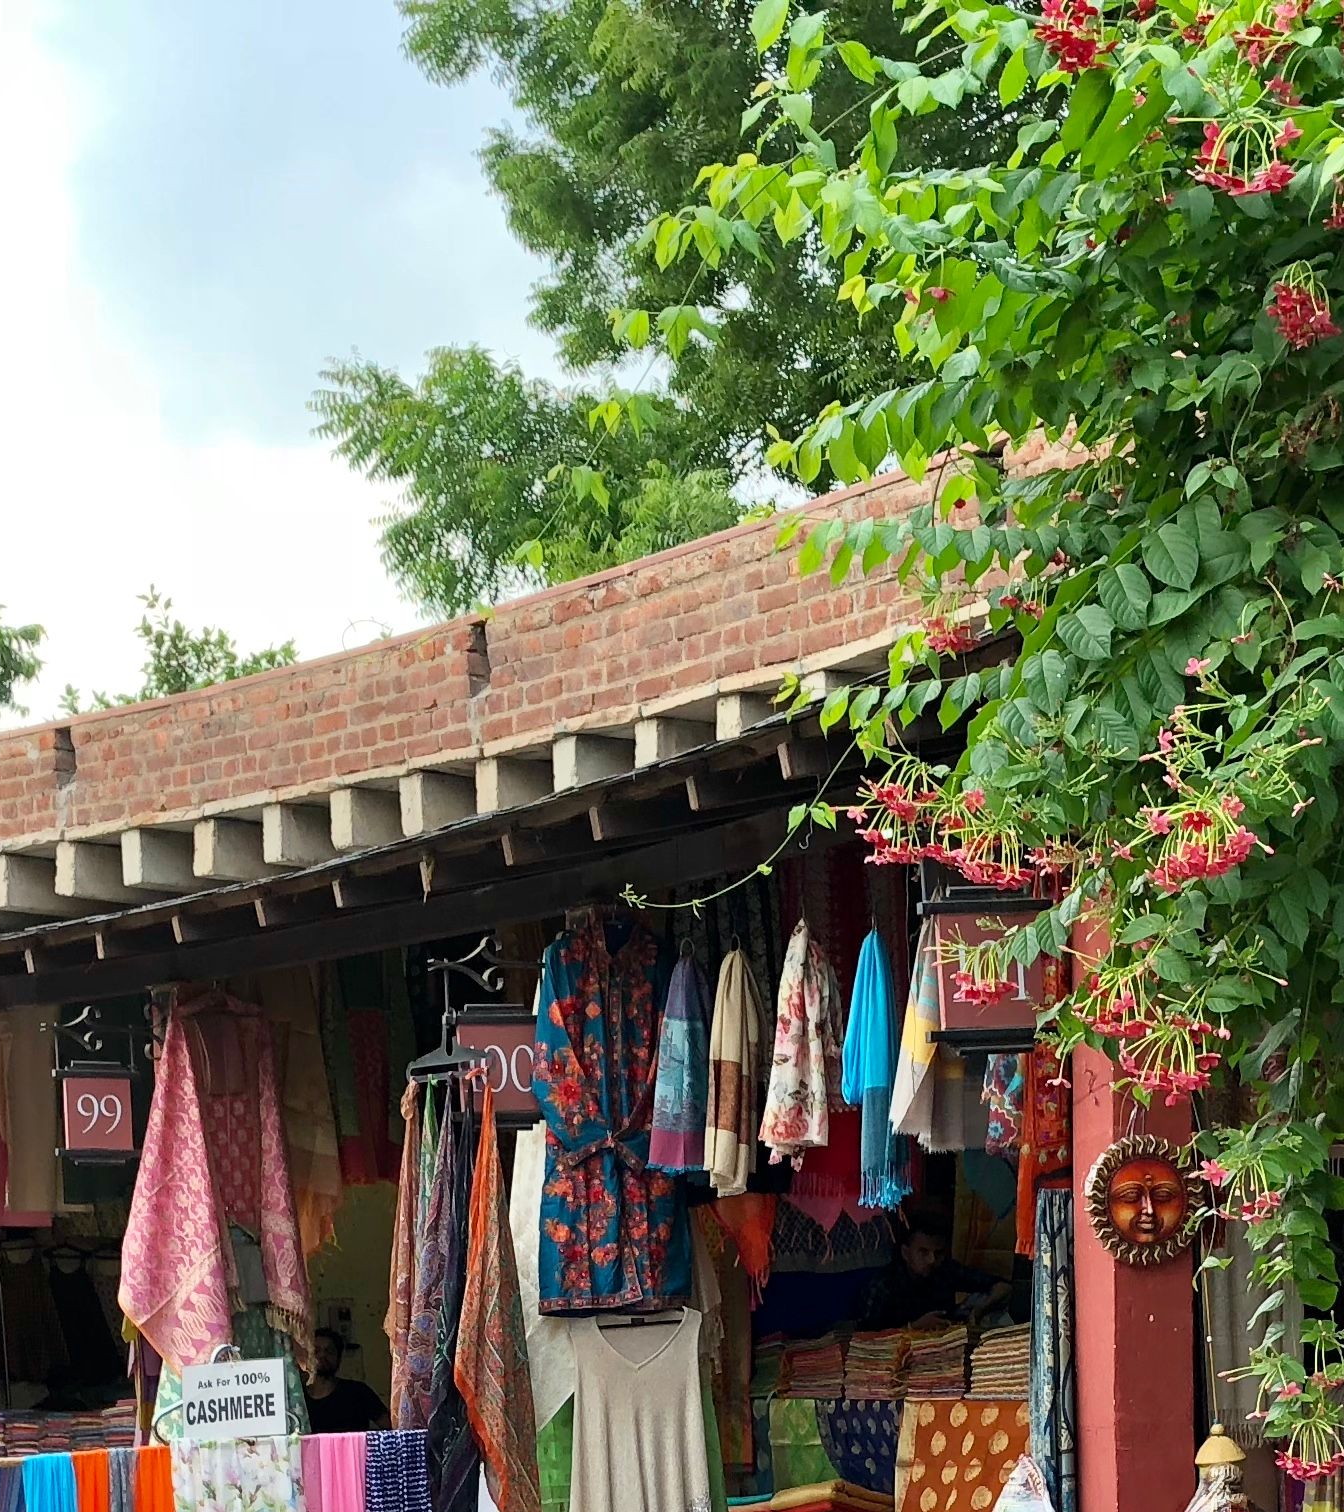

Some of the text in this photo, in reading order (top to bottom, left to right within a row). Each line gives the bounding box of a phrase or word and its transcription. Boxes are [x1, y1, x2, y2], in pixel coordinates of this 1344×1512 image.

[77, 1093, 122, 1134] 99
[198, 1372, 271, 1390] Ask For 100%
[186, 1392, 276, 1426] CASHMERE
